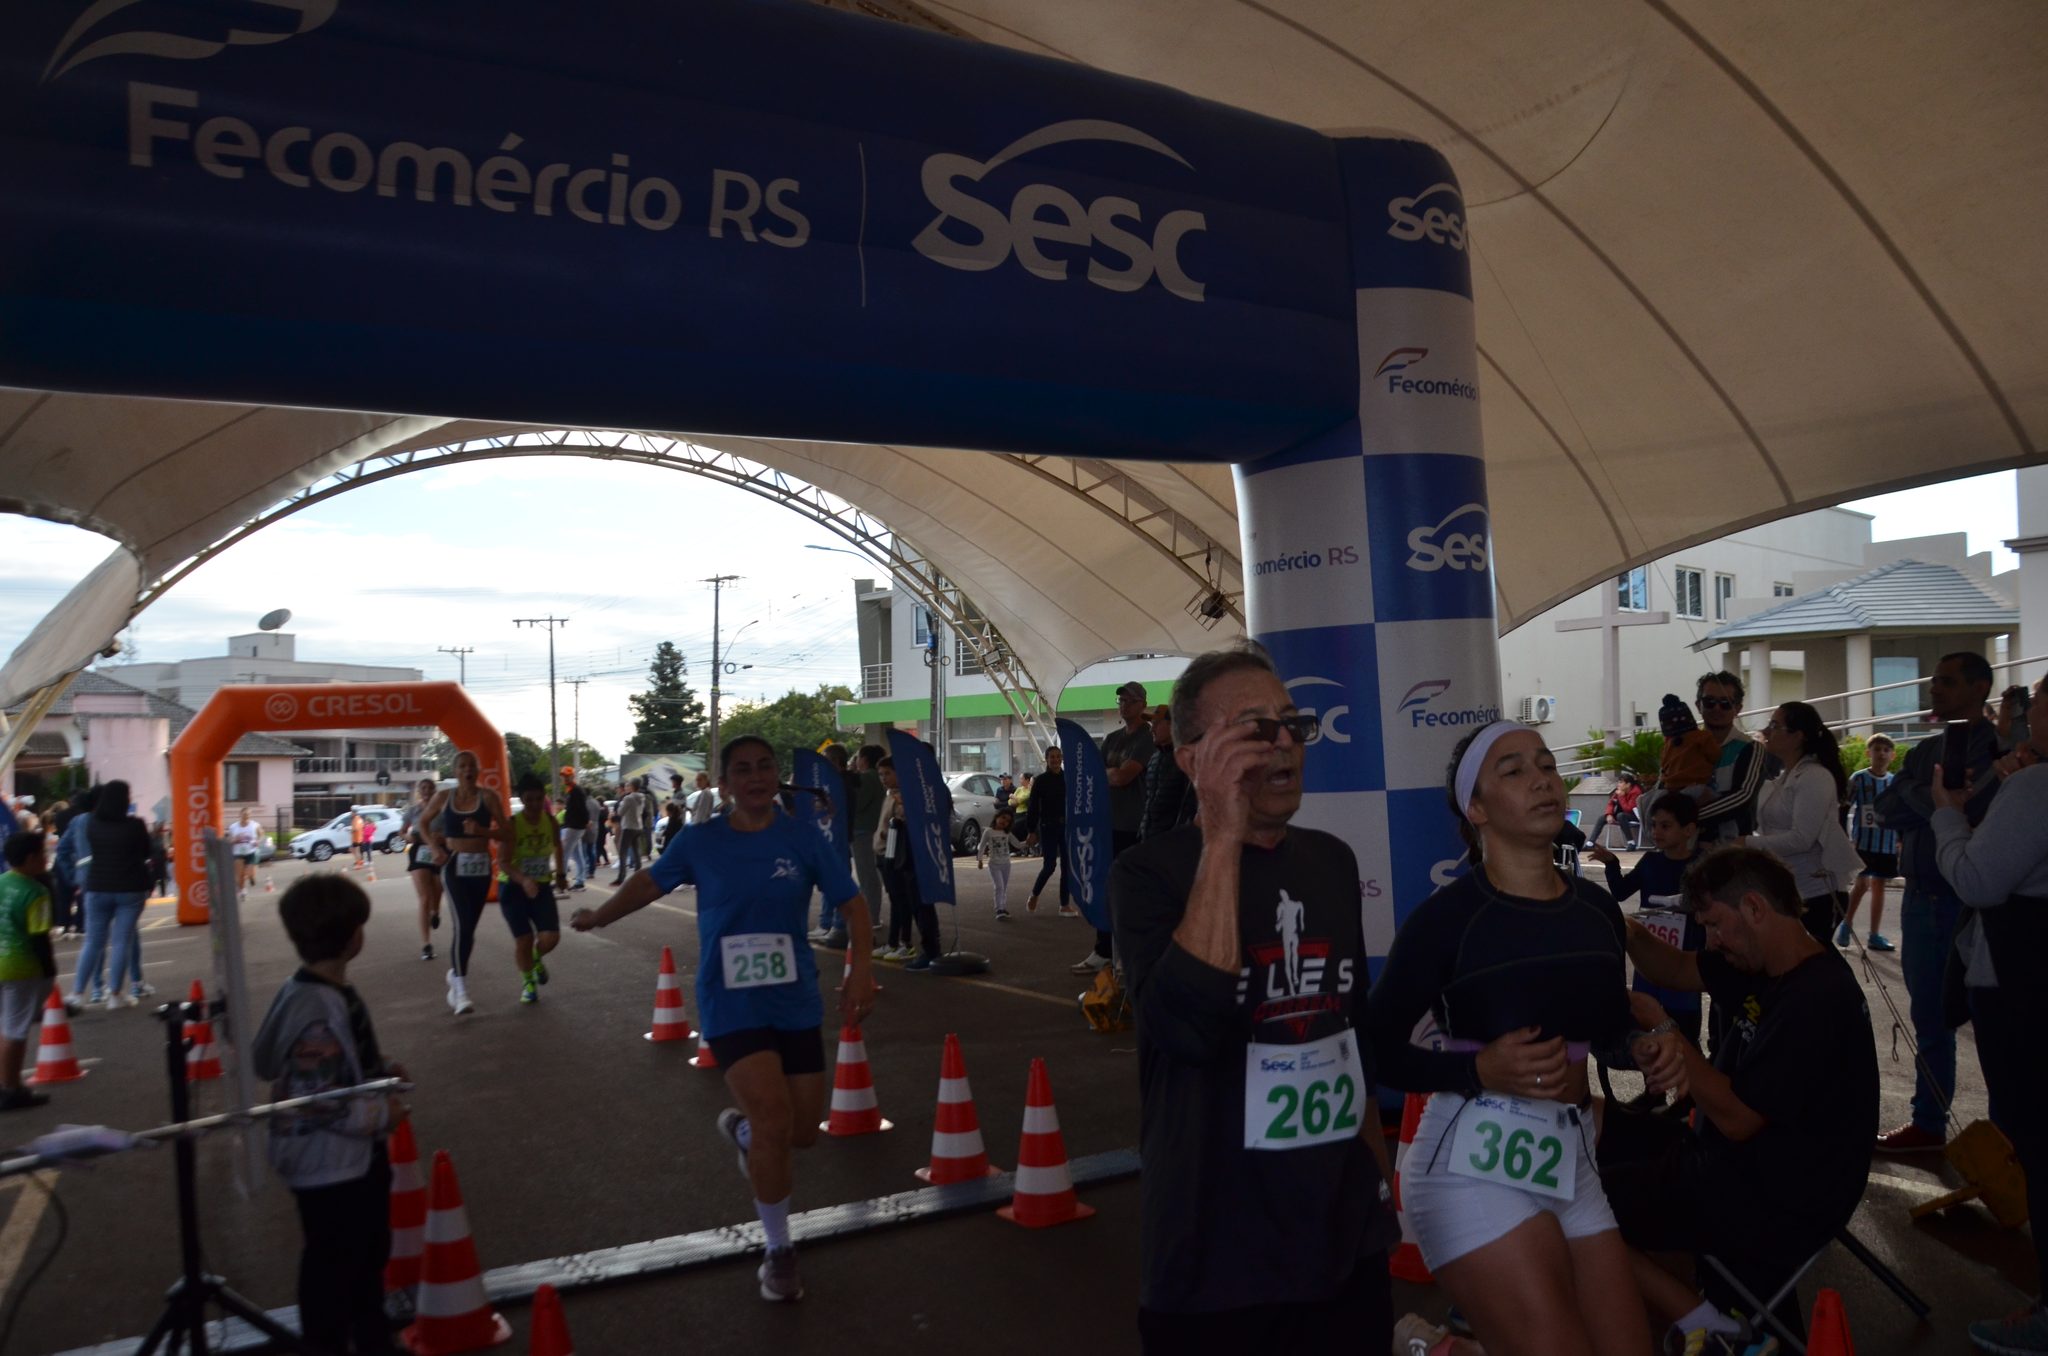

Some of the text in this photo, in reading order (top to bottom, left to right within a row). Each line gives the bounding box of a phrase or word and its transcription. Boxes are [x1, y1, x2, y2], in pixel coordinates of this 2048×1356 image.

[126, 80, 812, 249] Fecomércio RS
[910, 140, 1208, 302] Sesc
[1386, 193, 1470, 250] Ses
[1253, 545, 1359, 577] omércio RS
[1405, 520, 1489, 572] Ses
[307, 693, 422, 717] CRESOL
[1073, 741, 1084, 815] Fecomércio
[187, 776, 211, 875] CRESOL
[1074, 826, 1095, 904] Sesc
[733, 952, 787, 982] 258
[1264, 1073, 1358, 1140] 262
[1469, 1120, 1563, 1189] 362
